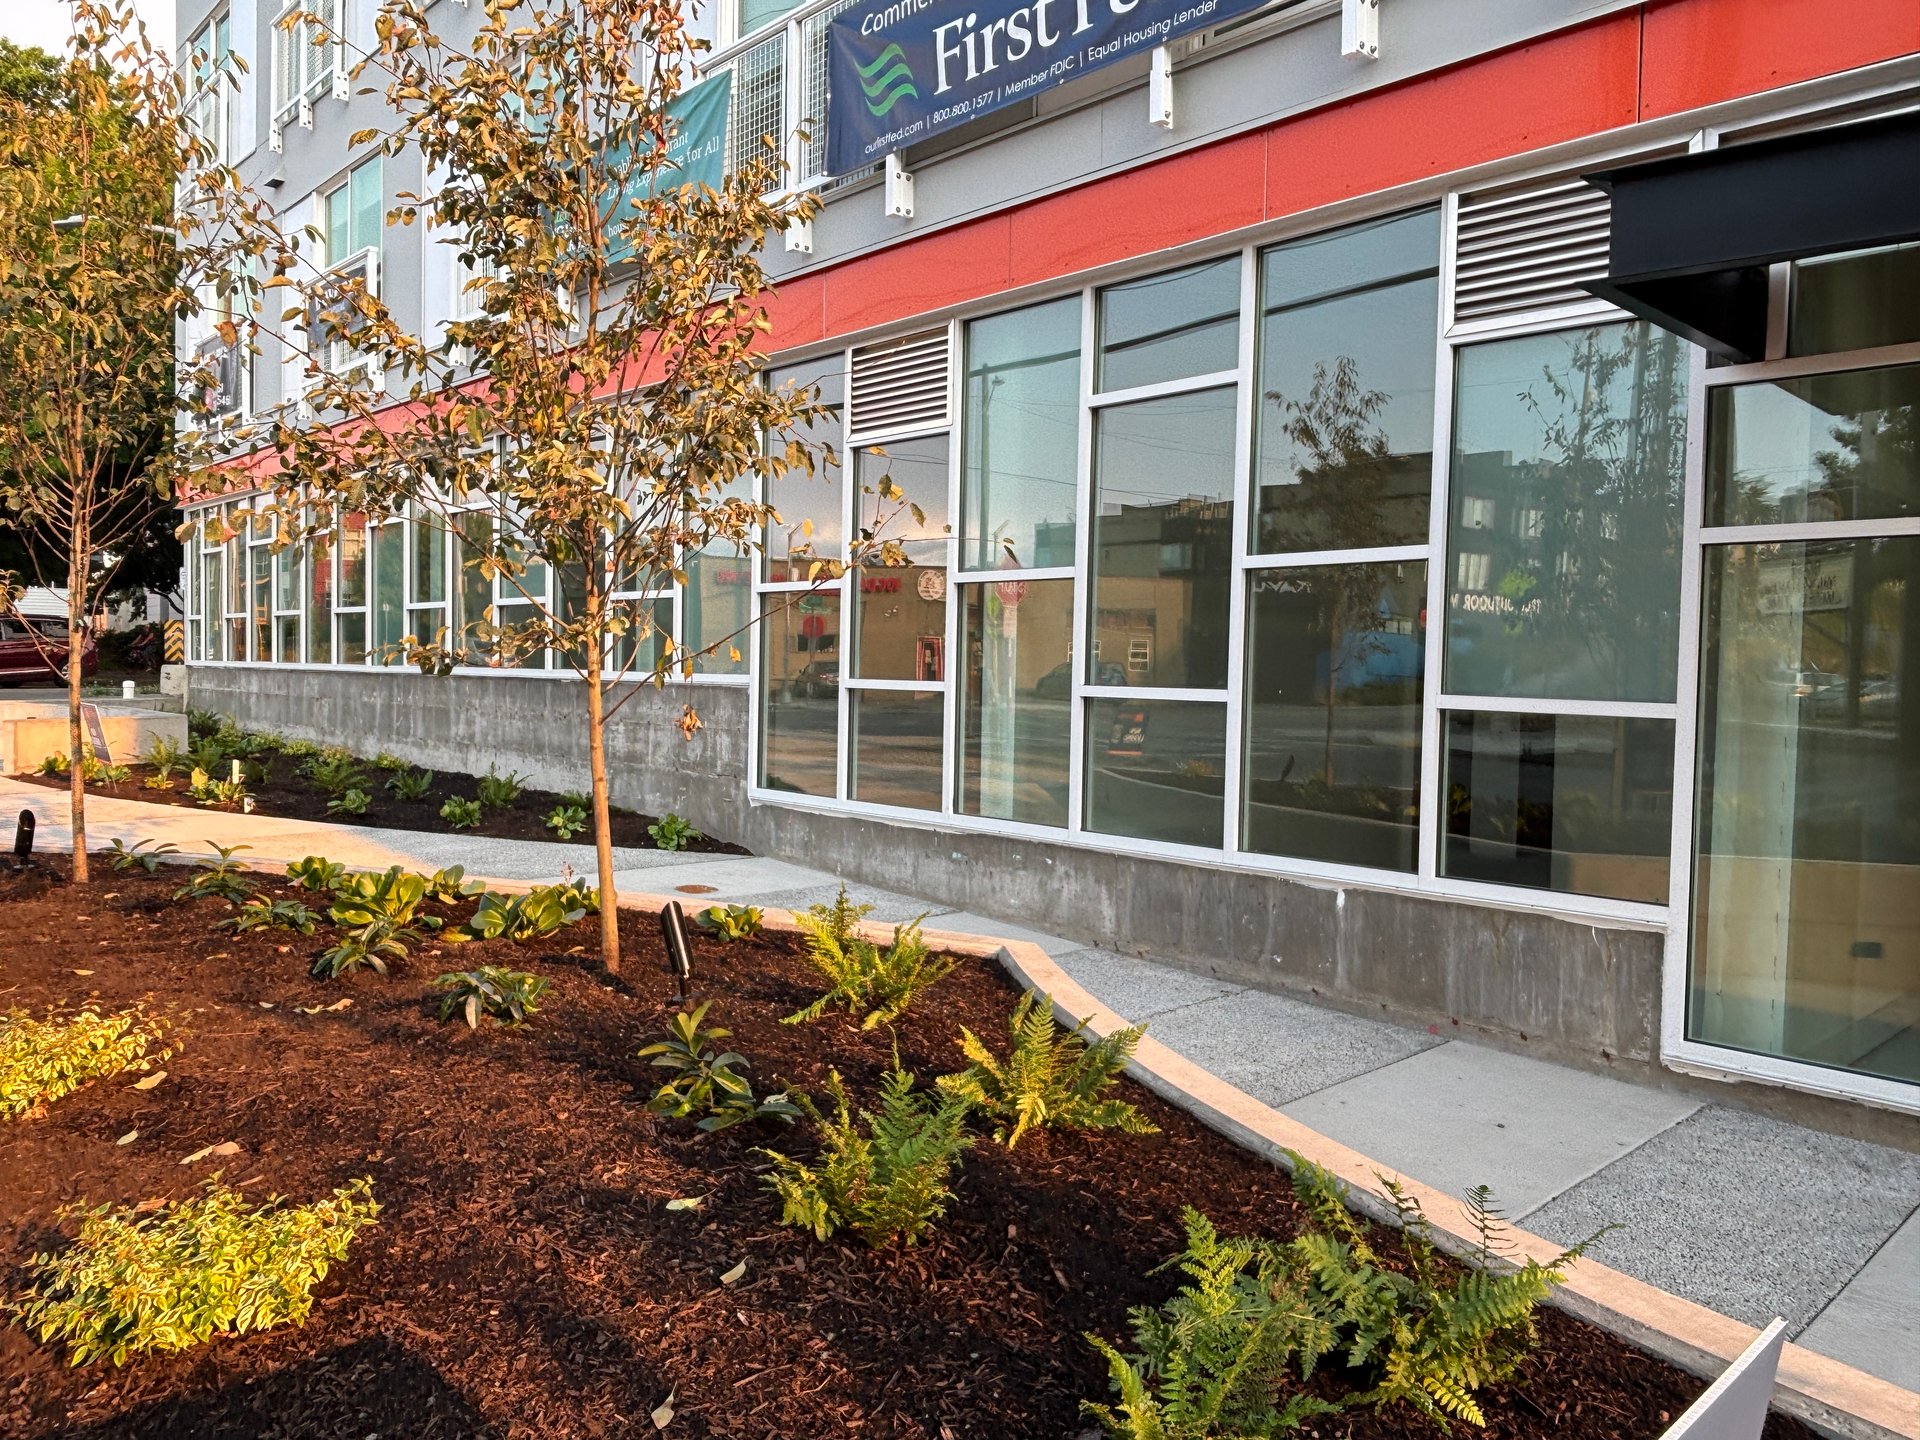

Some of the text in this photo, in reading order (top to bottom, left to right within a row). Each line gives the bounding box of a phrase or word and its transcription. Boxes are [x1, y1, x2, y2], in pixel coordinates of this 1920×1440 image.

[864, 119, 924, 154] ourfirstfed.com
[932, 90, 994, 124] 800.800.1577
[1005, 67, 1049, 97] Member
[1050, 55, 1074, 78] FDIC
[1088, 36, 1121, 62] Equal
[1123, 18, 1171, 48] Housing
[1173, 0, 1218, 26] Lender
[932, 0, 1060, 96] First
[687, 146, 703, 163] for
[704, 135, 719, 157] All
